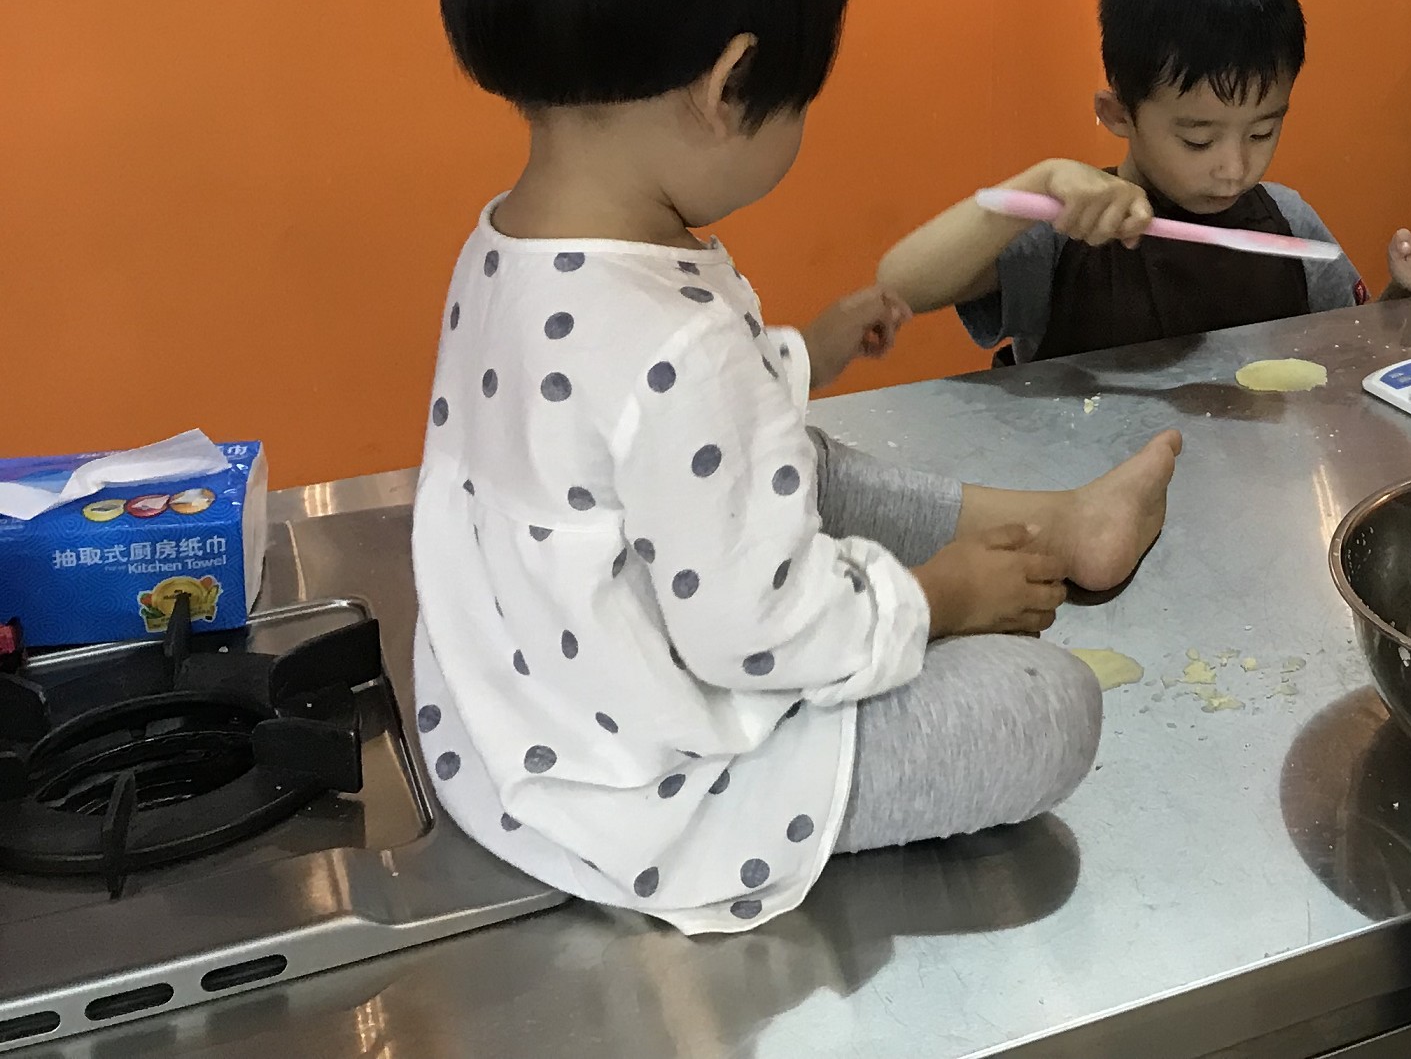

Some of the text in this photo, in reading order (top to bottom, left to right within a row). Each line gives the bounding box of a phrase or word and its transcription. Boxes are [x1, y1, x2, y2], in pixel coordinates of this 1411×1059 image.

[53, 535, 226, 569] 抽取式厨房纸巾
[128, 560, 182, 574] Kitchen
[187, 555, 227, 570] Towel
